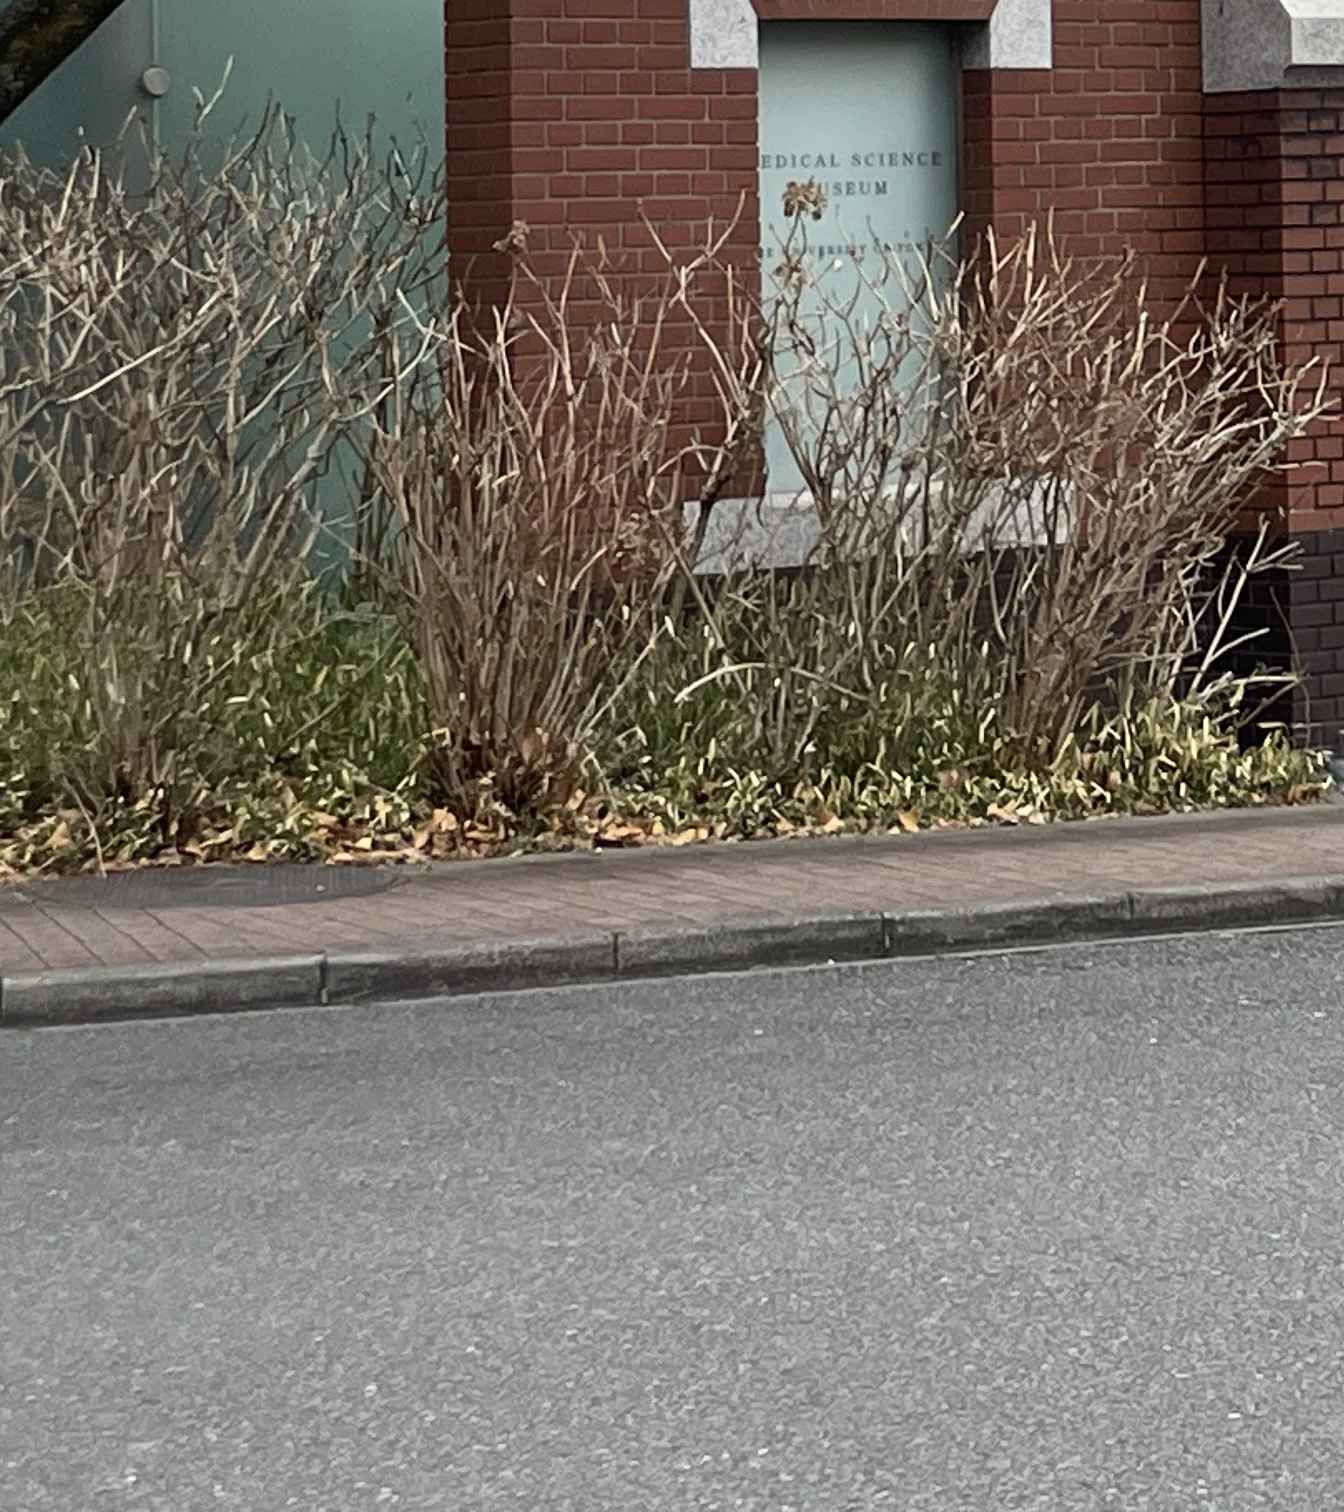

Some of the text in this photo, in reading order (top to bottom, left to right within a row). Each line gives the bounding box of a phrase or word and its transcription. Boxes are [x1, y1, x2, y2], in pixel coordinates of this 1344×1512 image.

[760, 151, 944, 169] EDICAL SCIENCE
[816, 180, 888, 196] USEUM
